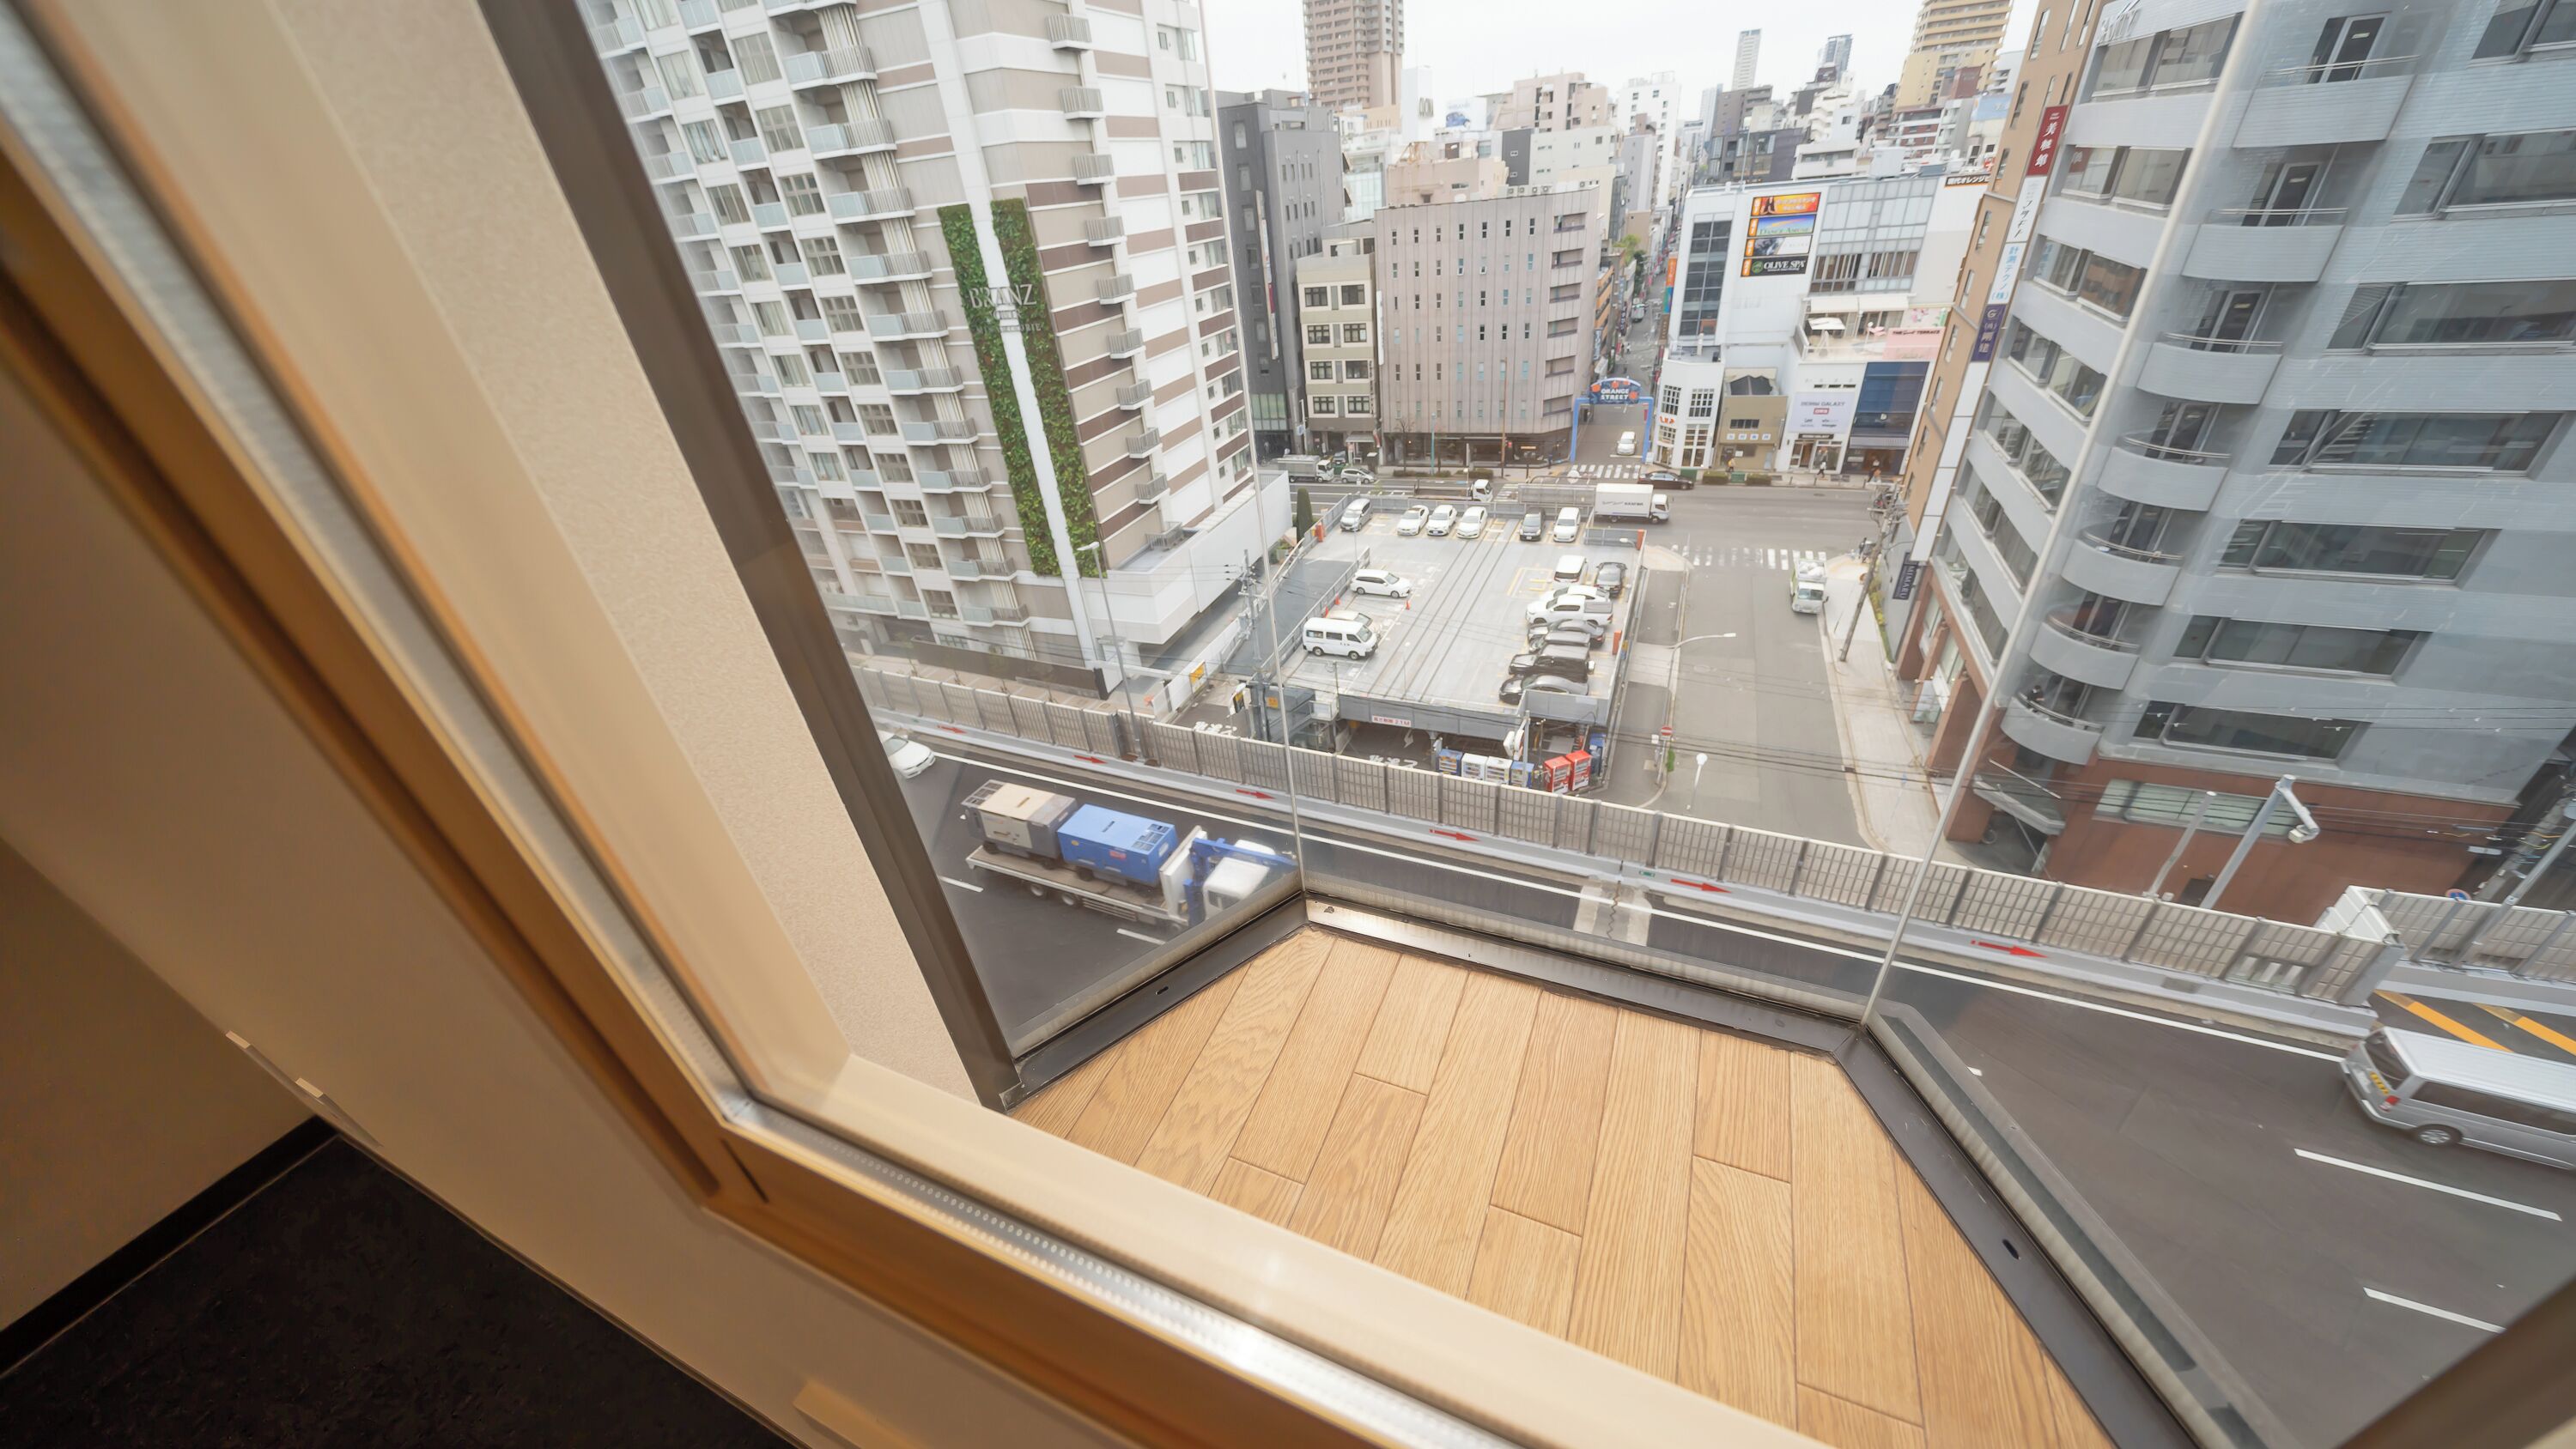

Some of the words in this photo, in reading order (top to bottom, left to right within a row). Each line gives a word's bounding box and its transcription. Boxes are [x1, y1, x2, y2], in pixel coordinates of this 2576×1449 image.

[1763, 260, 1789, 270] OLIVE
[1790, 259, 1806, 269] SPA
[969, 283, 1037, 308] BRANZ
[1899, 566, 1916, 598] MIMARU
